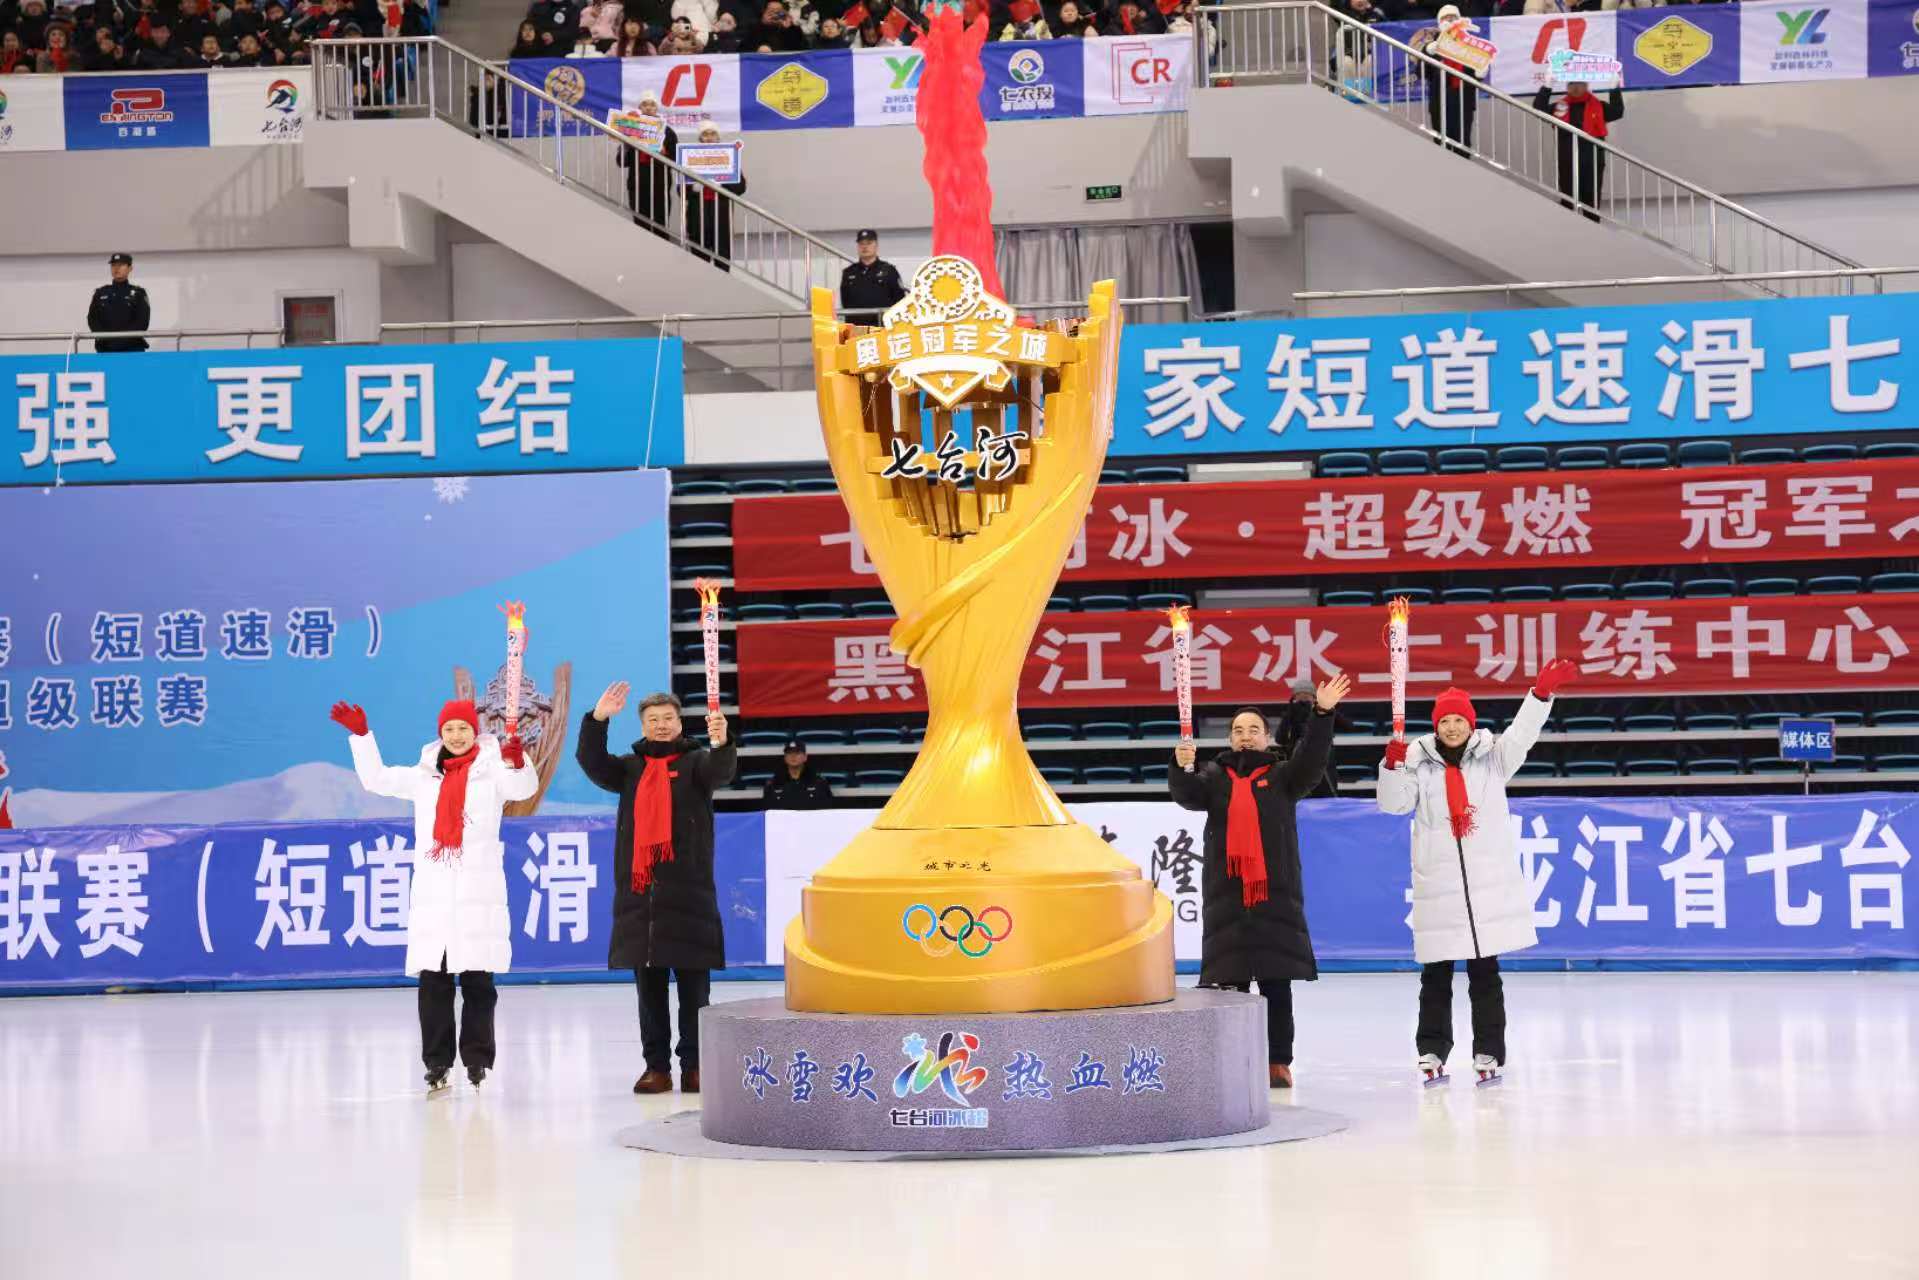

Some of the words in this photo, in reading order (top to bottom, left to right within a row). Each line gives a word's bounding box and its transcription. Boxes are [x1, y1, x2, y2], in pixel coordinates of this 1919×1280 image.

[1000, 86, 1053, 103] 七农投
[1131, 57, 1172, 85] CR
[856, 325, 1048, 367] 奥运冠军之城
[1143, 314, 1902, 439] 家短道速滑七
[17, 371, 117, 467] 强
[207, 356, 575, 462] 更团结
[881, 426, 1028, 481] 七台河
[827, 605, 1910, 702] 黑江省冰上训练中心
[0, 673, 207, 729] 级联赛
[1783, 731, 1832, 749] 媒体区
[1101, 825, 1207, 894] 隆
[1405, 808, 1912, 930] 龙江省七台
[743, 1047, 878, 1104] 冰雪欢
[1002, 1045, 1167, 1102] 热血燃
